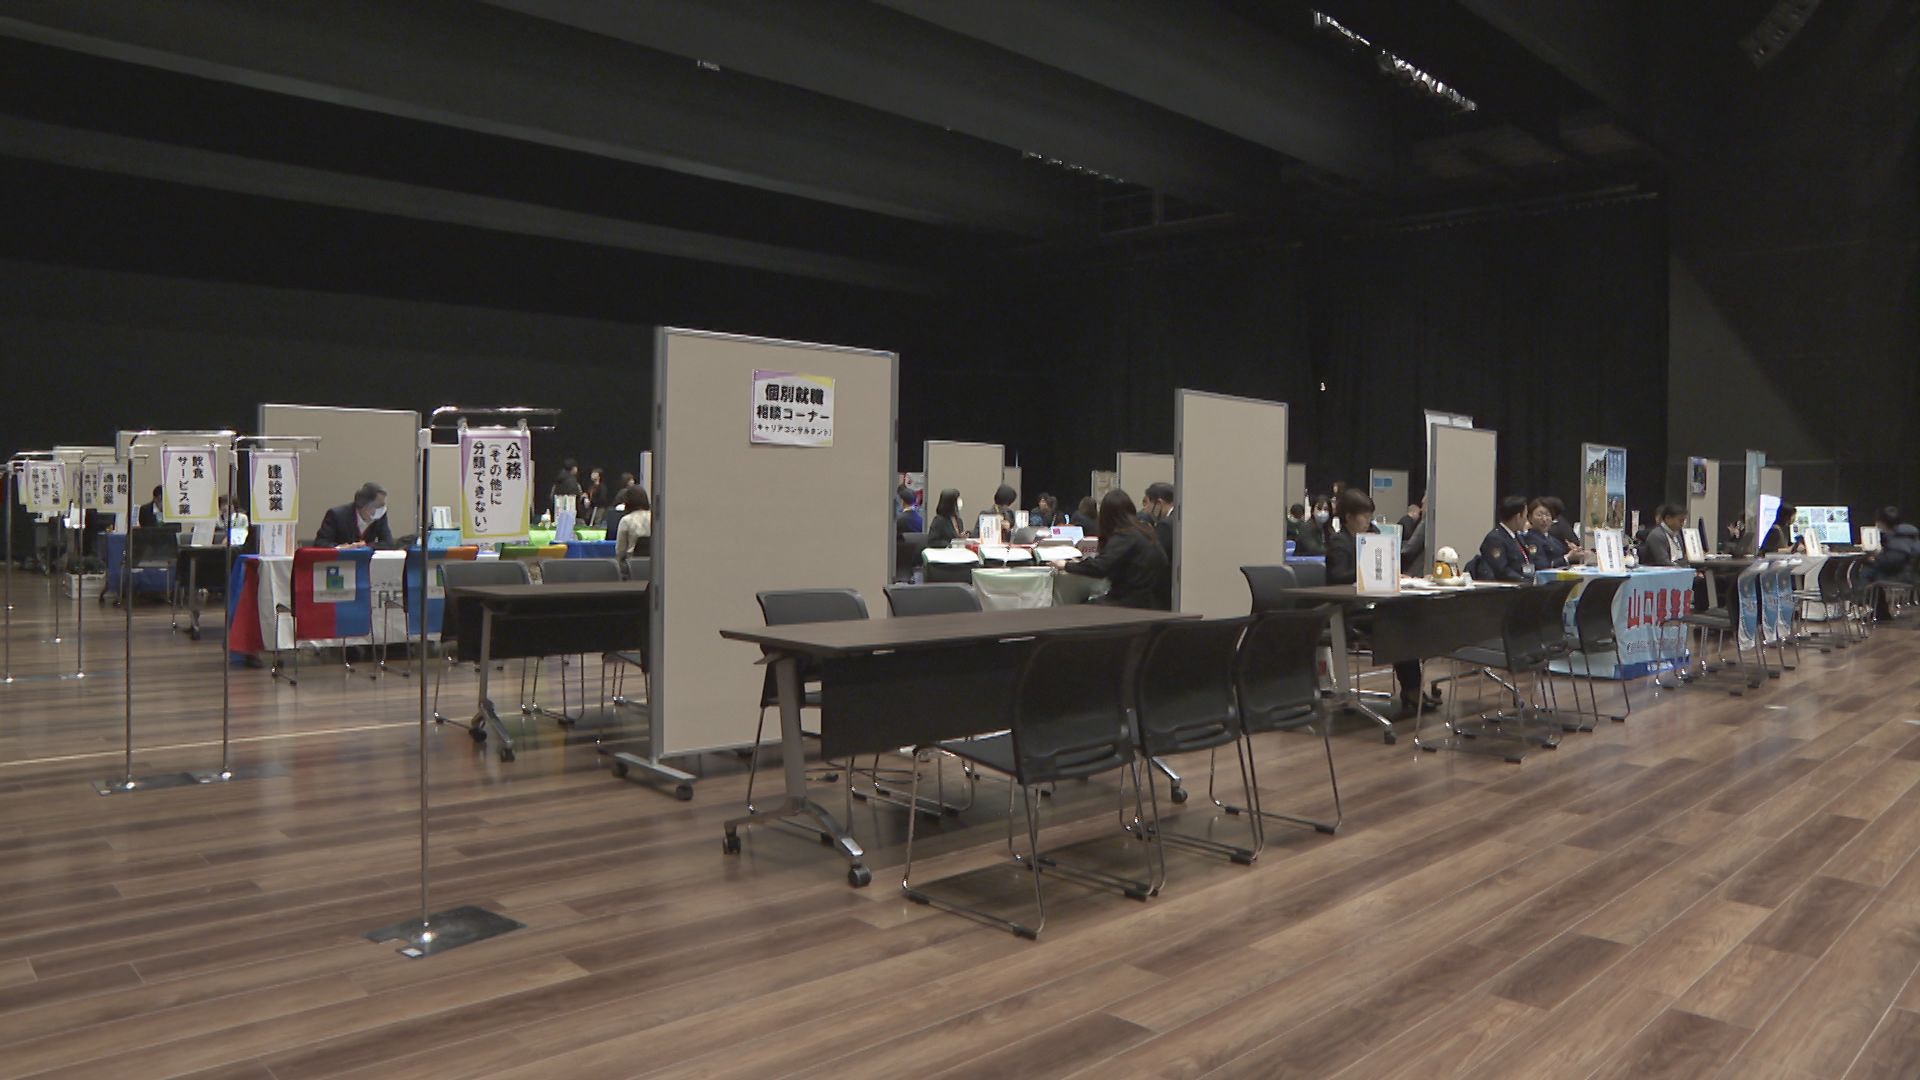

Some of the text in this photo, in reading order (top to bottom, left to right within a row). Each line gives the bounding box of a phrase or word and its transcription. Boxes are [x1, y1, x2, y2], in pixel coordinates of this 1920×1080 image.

[765, 383, 824, 405] 個別就職
[757, 404, 830, 422] 相談コーナー
[192, 456, 204, 479] 飲食
[506, 442, 522, 480] 公務
[177, 456, 191, 515] サービス業
[267, 464, 283, 511] 建設業
